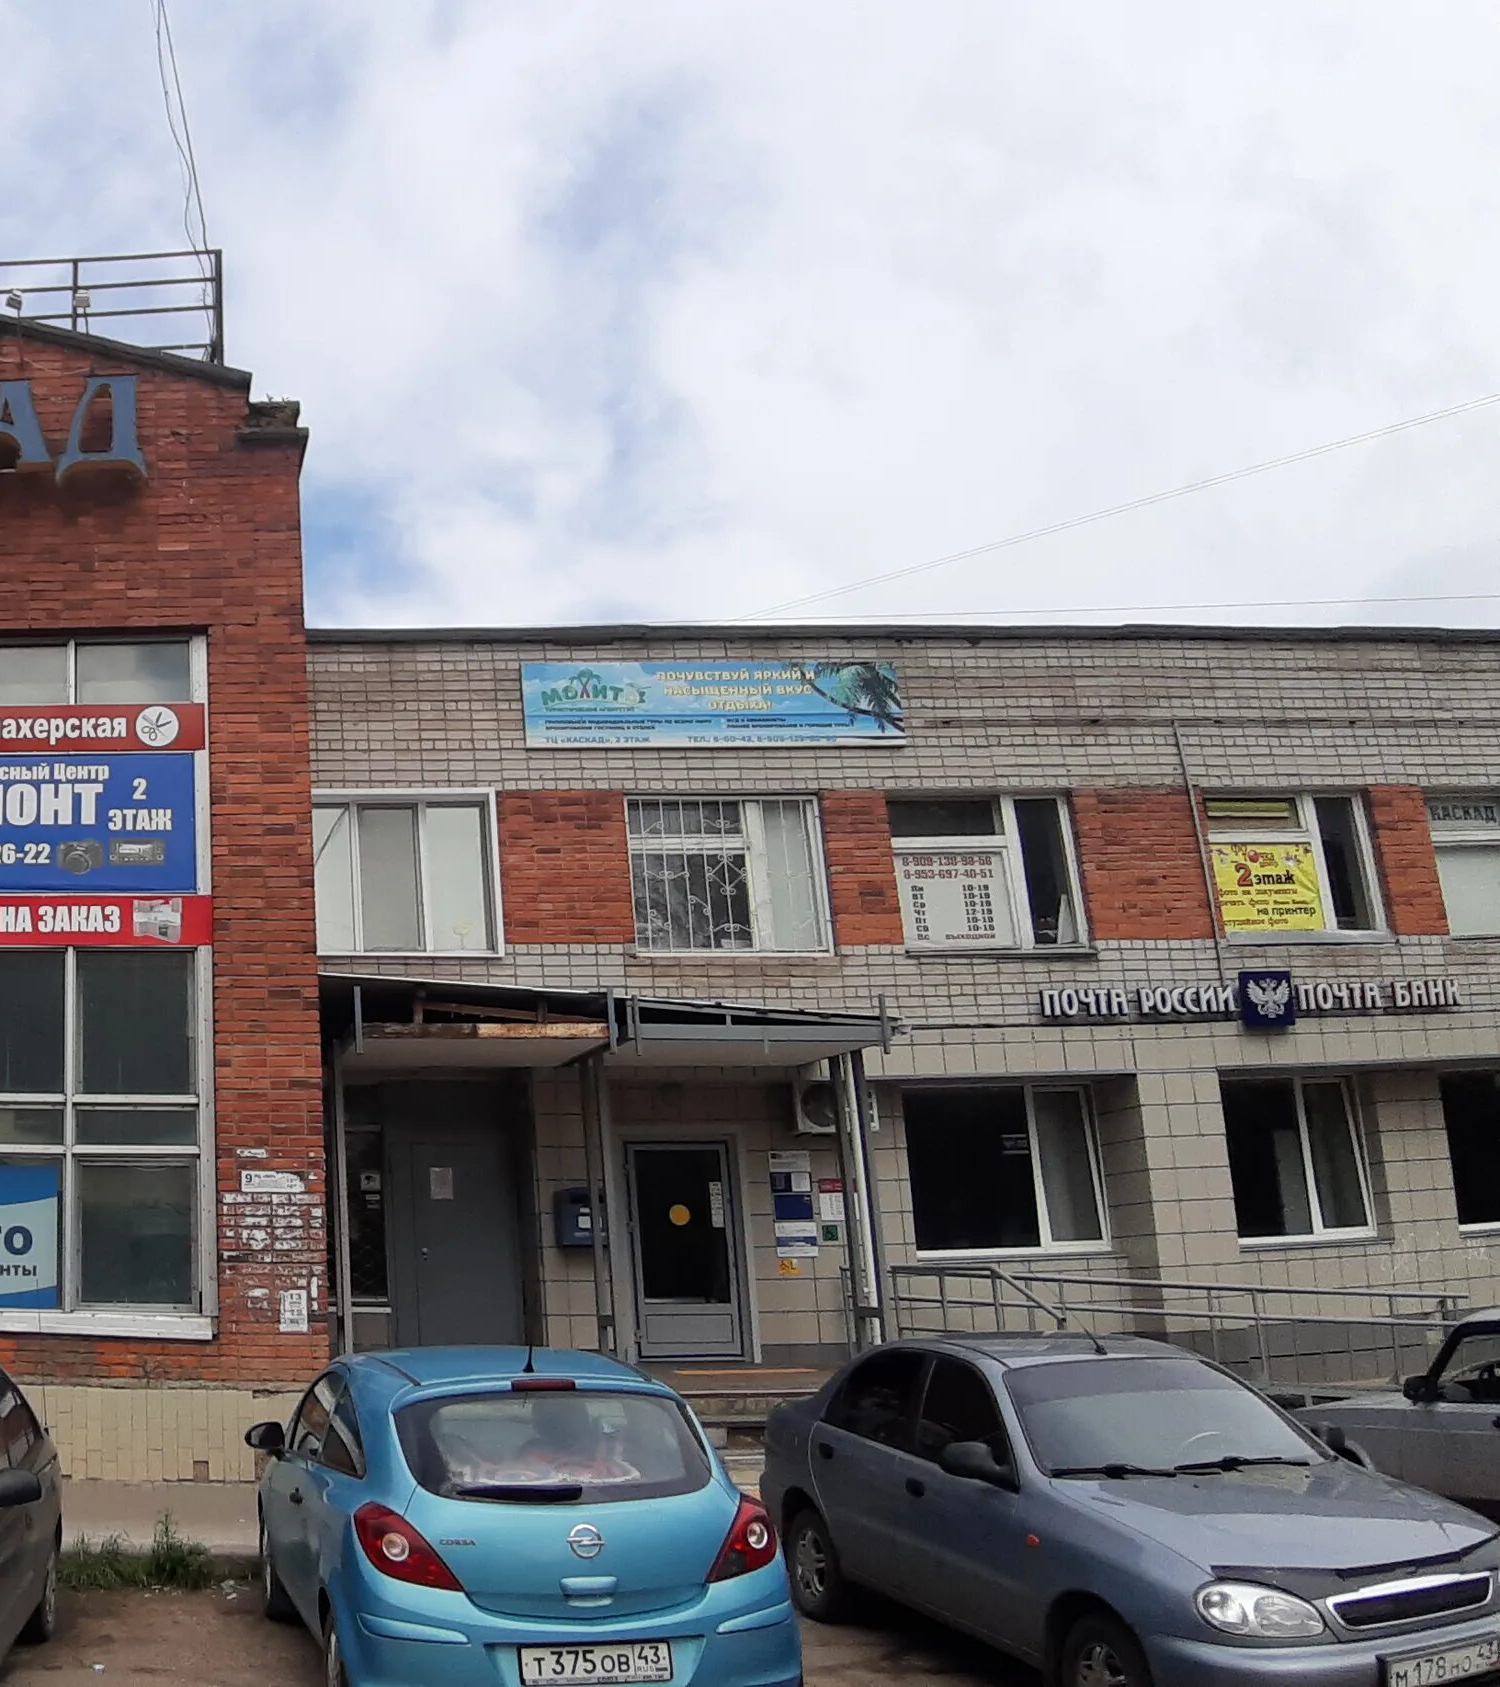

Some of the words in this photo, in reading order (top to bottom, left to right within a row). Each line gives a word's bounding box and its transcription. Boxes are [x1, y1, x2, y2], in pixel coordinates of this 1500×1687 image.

[656, 668, 749, 681] ПОЧУВСТВУЙ
[754, 667, 802, 680] ЯРКИЙ
[664, 683, 772, 696] НАСЫЩЕННЫЙ
[777, 685, 813, 695] ВКУС
[53, 763, 109, 781] Центр
[132, 777, 147, 800] 2
[108, 809, 172, 830] ЭТАЖ
[1430, 806, 1497, 824] КАСКАД
[1235, 863, 1253, 887] 2
[1254, 870, 1296, 886] этаж
[0, 905, 34, 932] НА
[38, 904, 121, 932] ЗАКАЗ
[1272, 907, 1316, 917] принтер
[1040, 987, 1128, 1018] ПОЧТА
[1139, 984, 1237, 1016] РОССИИ
[1300, 981, 1382, 1010] ПОЧТА
[1394, 979, 1461, 1008] БАНК
[637, 1645, 660, 1665] 43
